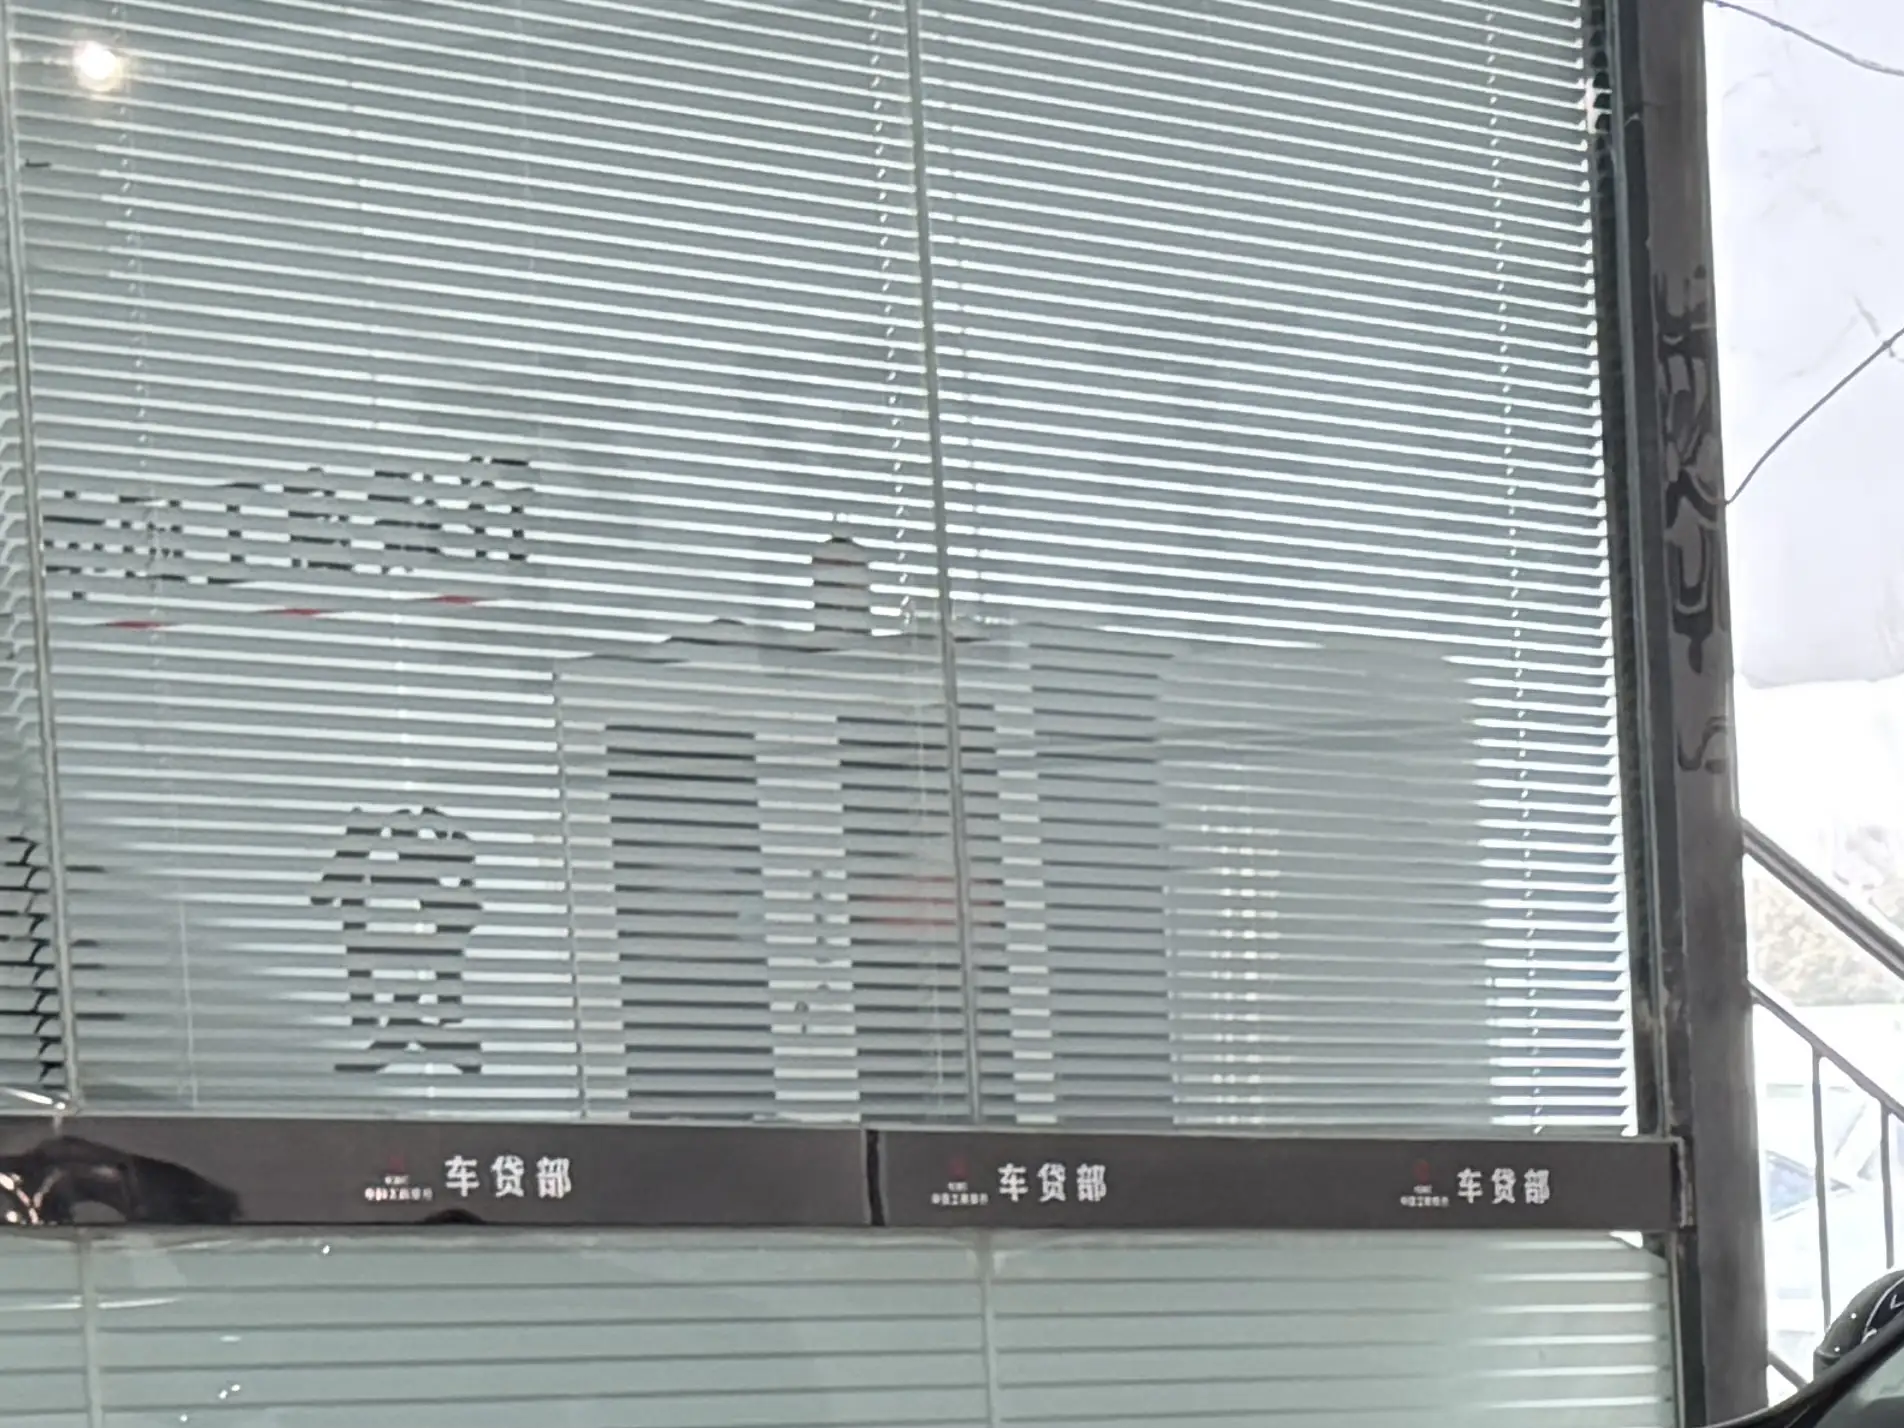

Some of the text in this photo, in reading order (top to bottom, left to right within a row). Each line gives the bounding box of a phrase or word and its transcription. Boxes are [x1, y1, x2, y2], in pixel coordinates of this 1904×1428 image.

[444, 1154, 572, 1198] 车贷部
[997, 1162, 1108, 1202] 车贷部
[1456, 1166, 1551, 1204] 车贷部
